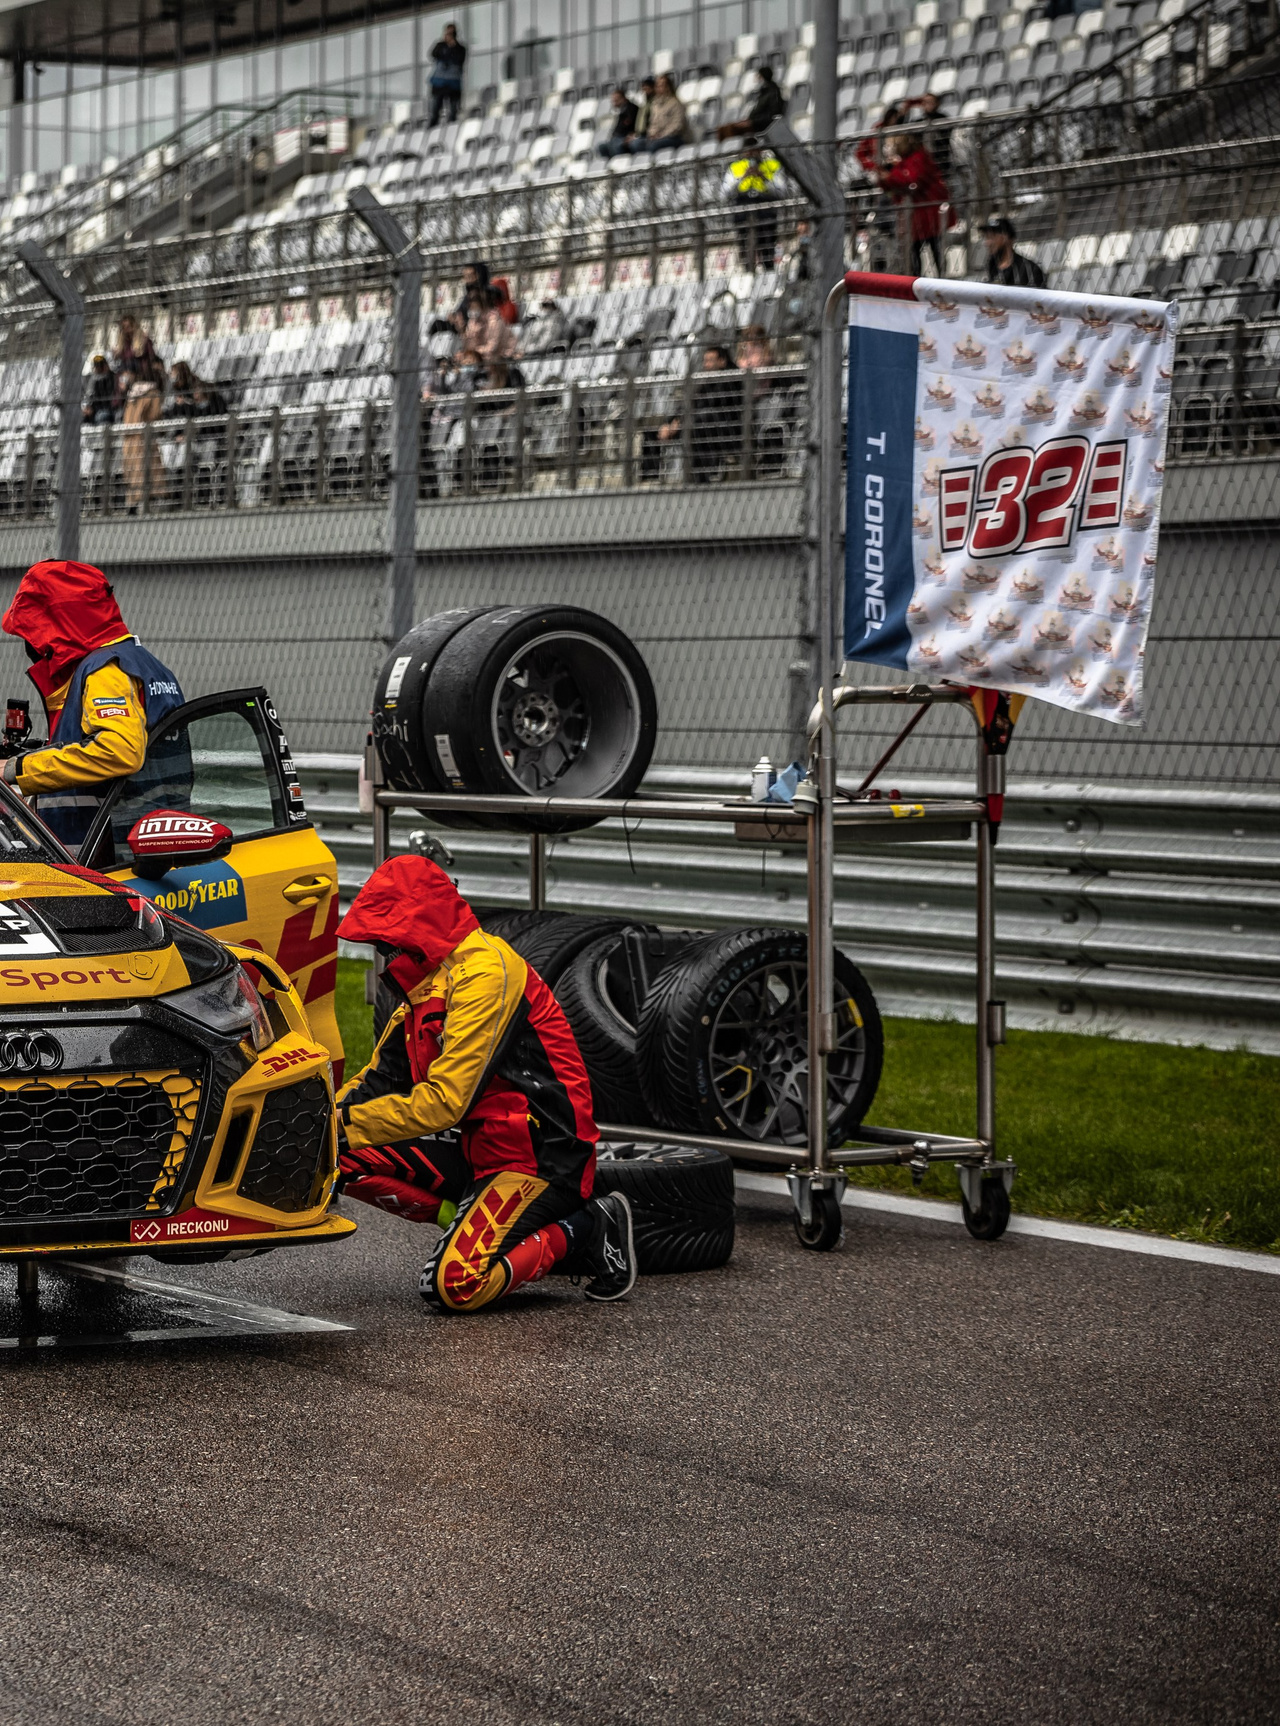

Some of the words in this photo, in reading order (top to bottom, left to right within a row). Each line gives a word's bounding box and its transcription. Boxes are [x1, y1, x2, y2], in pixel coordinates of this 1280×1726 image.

[866, 431, 887, 462] T.
[968, 435, 1091, 559] 32
[864, 474, 887, 639] CORONEL
[138, 816, 219, 834] inTrax
[148, 879, 239, 912] OODYEAR
[0, 966, 132, 994] Sport
[261, 1047, 324, 1073] DHL
[167, 1219, 229, 1236] IRECKONU
